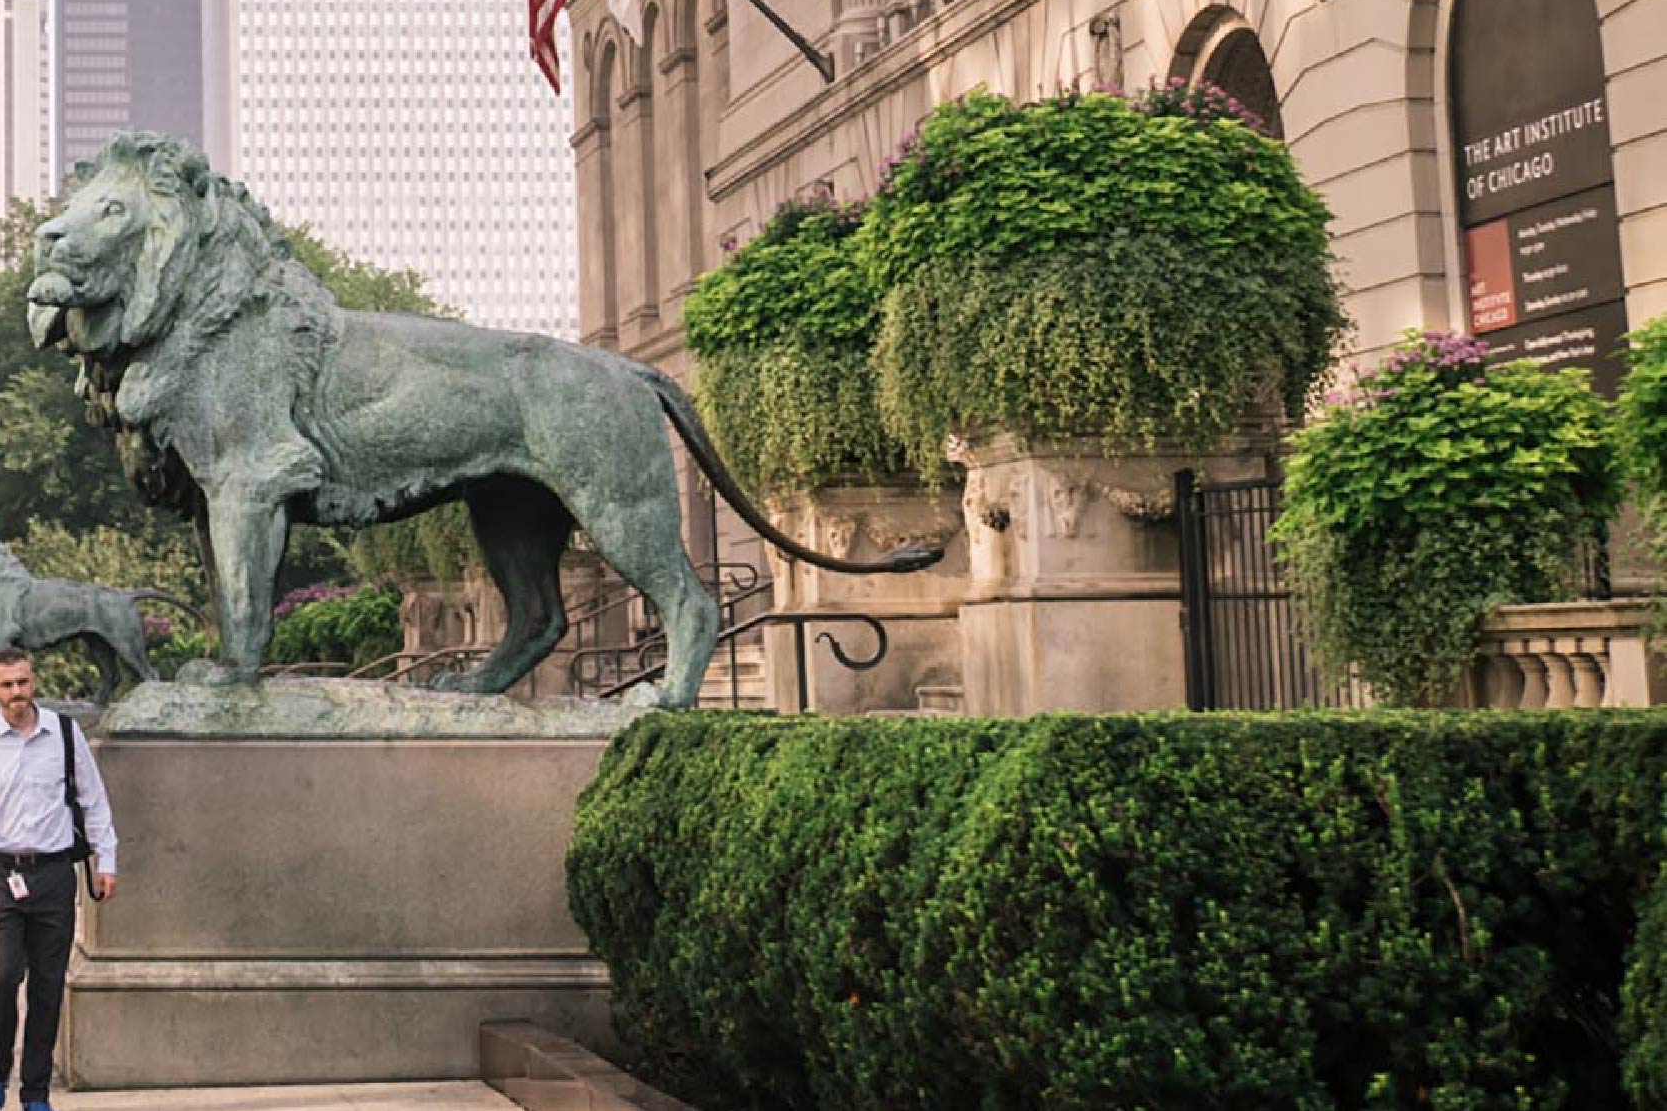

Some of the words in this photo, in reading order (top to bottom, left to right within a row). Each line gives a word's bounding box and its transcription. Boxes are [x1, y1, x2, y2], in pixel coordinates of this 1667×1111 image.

[1464, 137, 1491, 167] THE
[1494, 126, 1520, 157] ART
[1523, 97, 1604, 145] INSTITUTE
[1467, 174, 1484, 200] OF
[1488, 152, 1554, 193] CHICAGO
